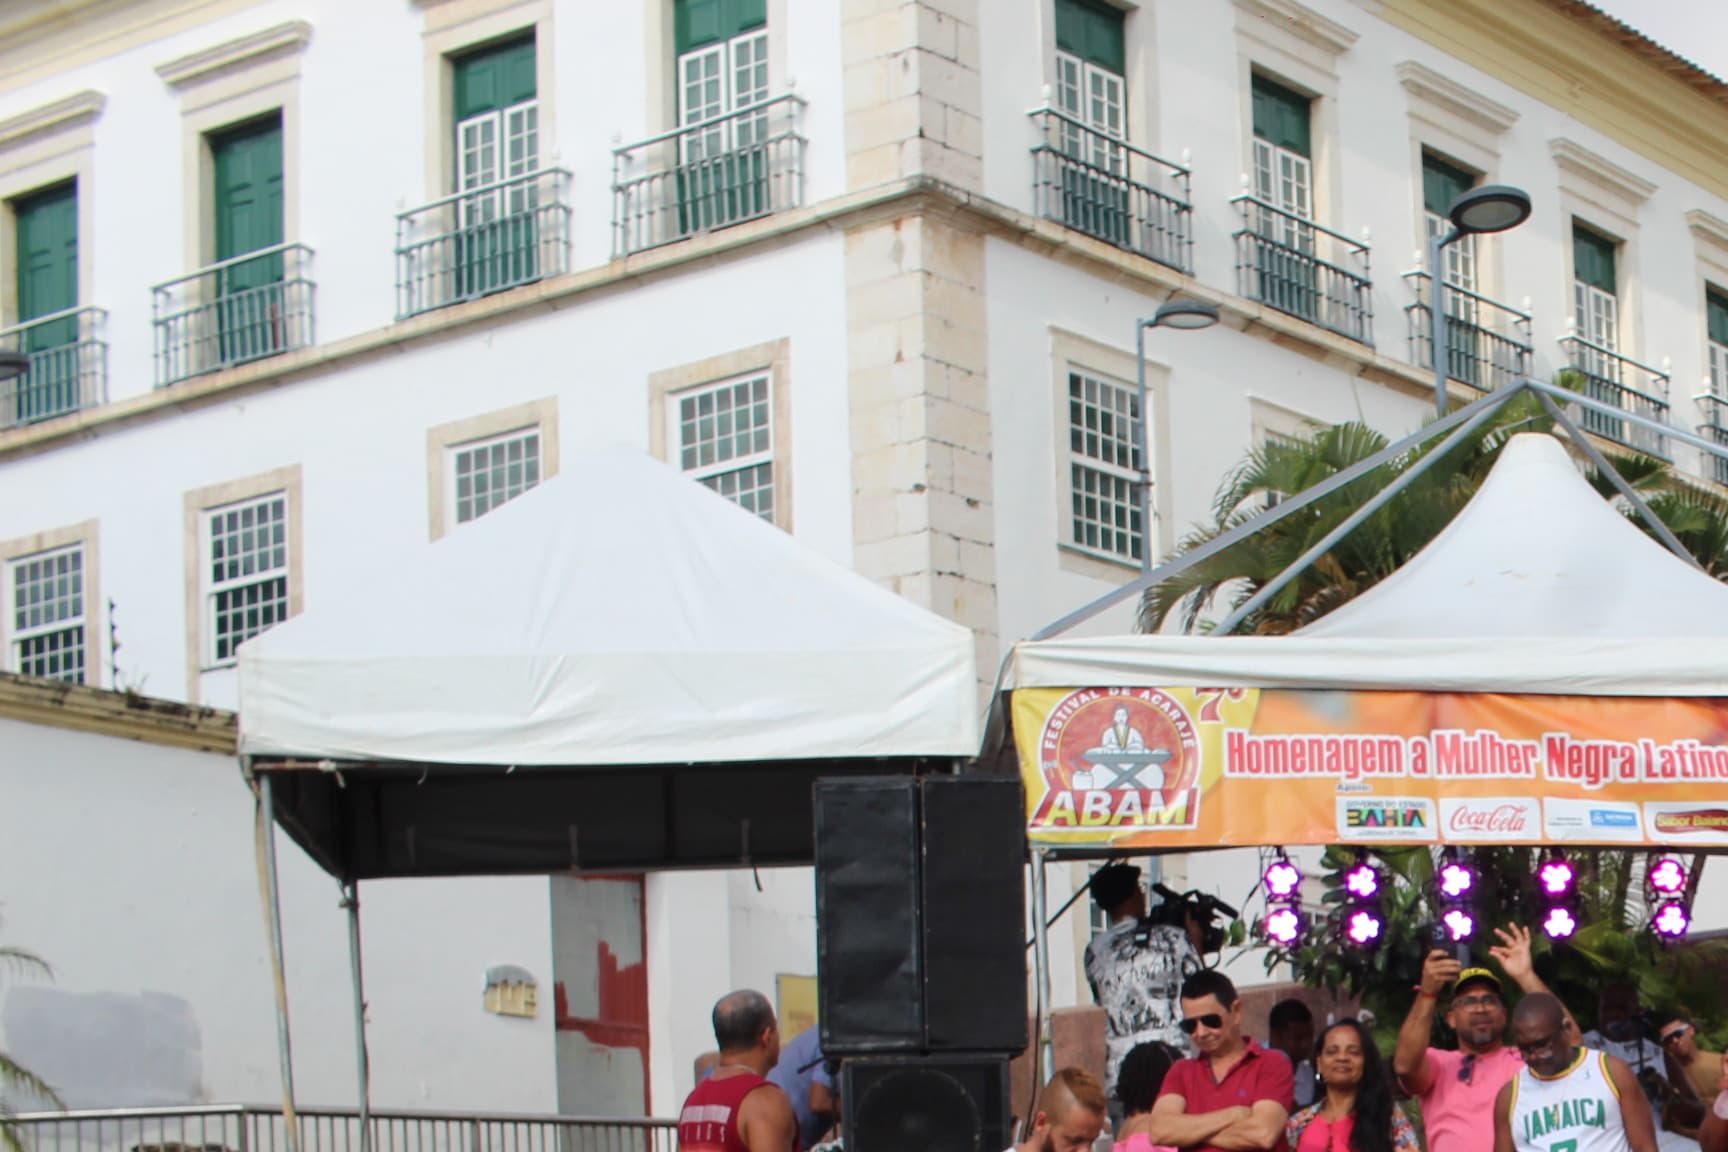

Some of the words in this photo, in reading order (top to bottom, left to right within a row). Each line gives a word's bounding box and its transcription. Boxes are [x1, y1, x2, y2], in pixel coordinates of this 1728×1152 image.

[1044, 689, 1101, 749] FESTIVAL
[1225, 731, 1405, 781] Homenagem
[1411, 738, 1429, 774] a
[1434, 732, 1539, 776] Mulher
[1545, 735, 1637, 786] Negra
[1043, 788, 1190, 826] ABAM
[1346, 808, 1427, 828] BAHIA
[1524, 1098, 1606, 1143] JAMAICA
